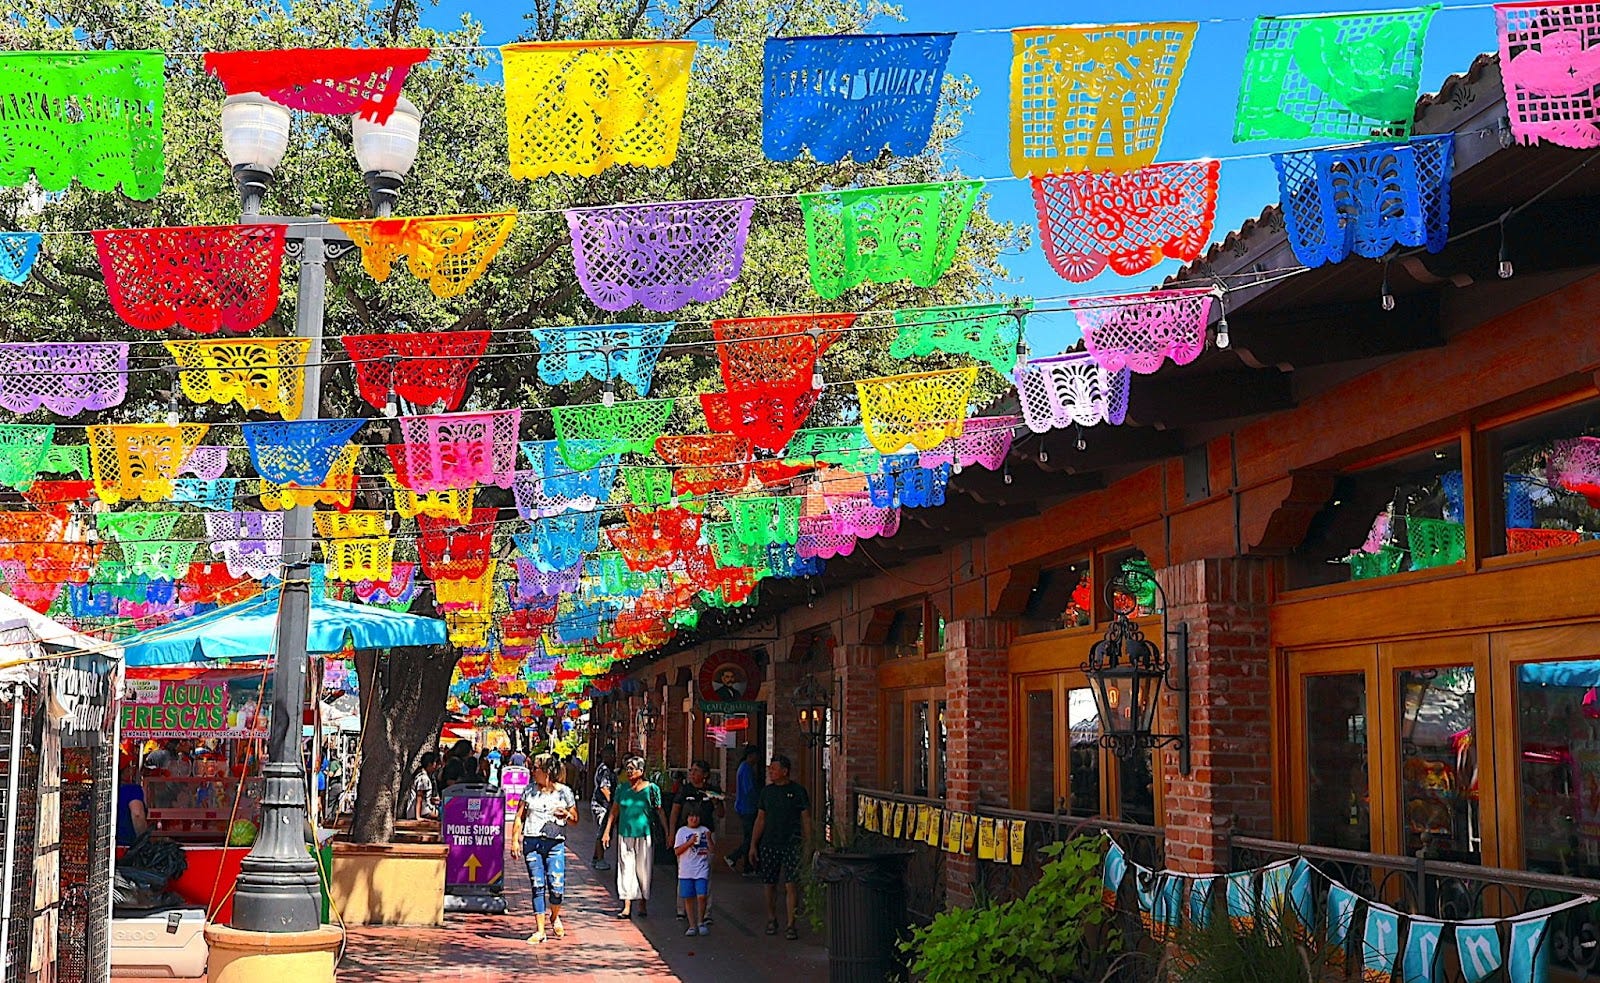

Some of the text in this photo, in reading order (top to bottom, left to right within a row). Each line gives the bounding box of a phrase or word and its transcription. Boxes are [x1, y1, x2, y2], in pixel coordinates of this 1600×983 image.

[163, 685, 223, 706] AGUAS
[121, 706, 223, 729] FRESCAS
[447, 824, 500, 836] MORE SHOPS
[453, 835, 494, 846] THIS WAY
